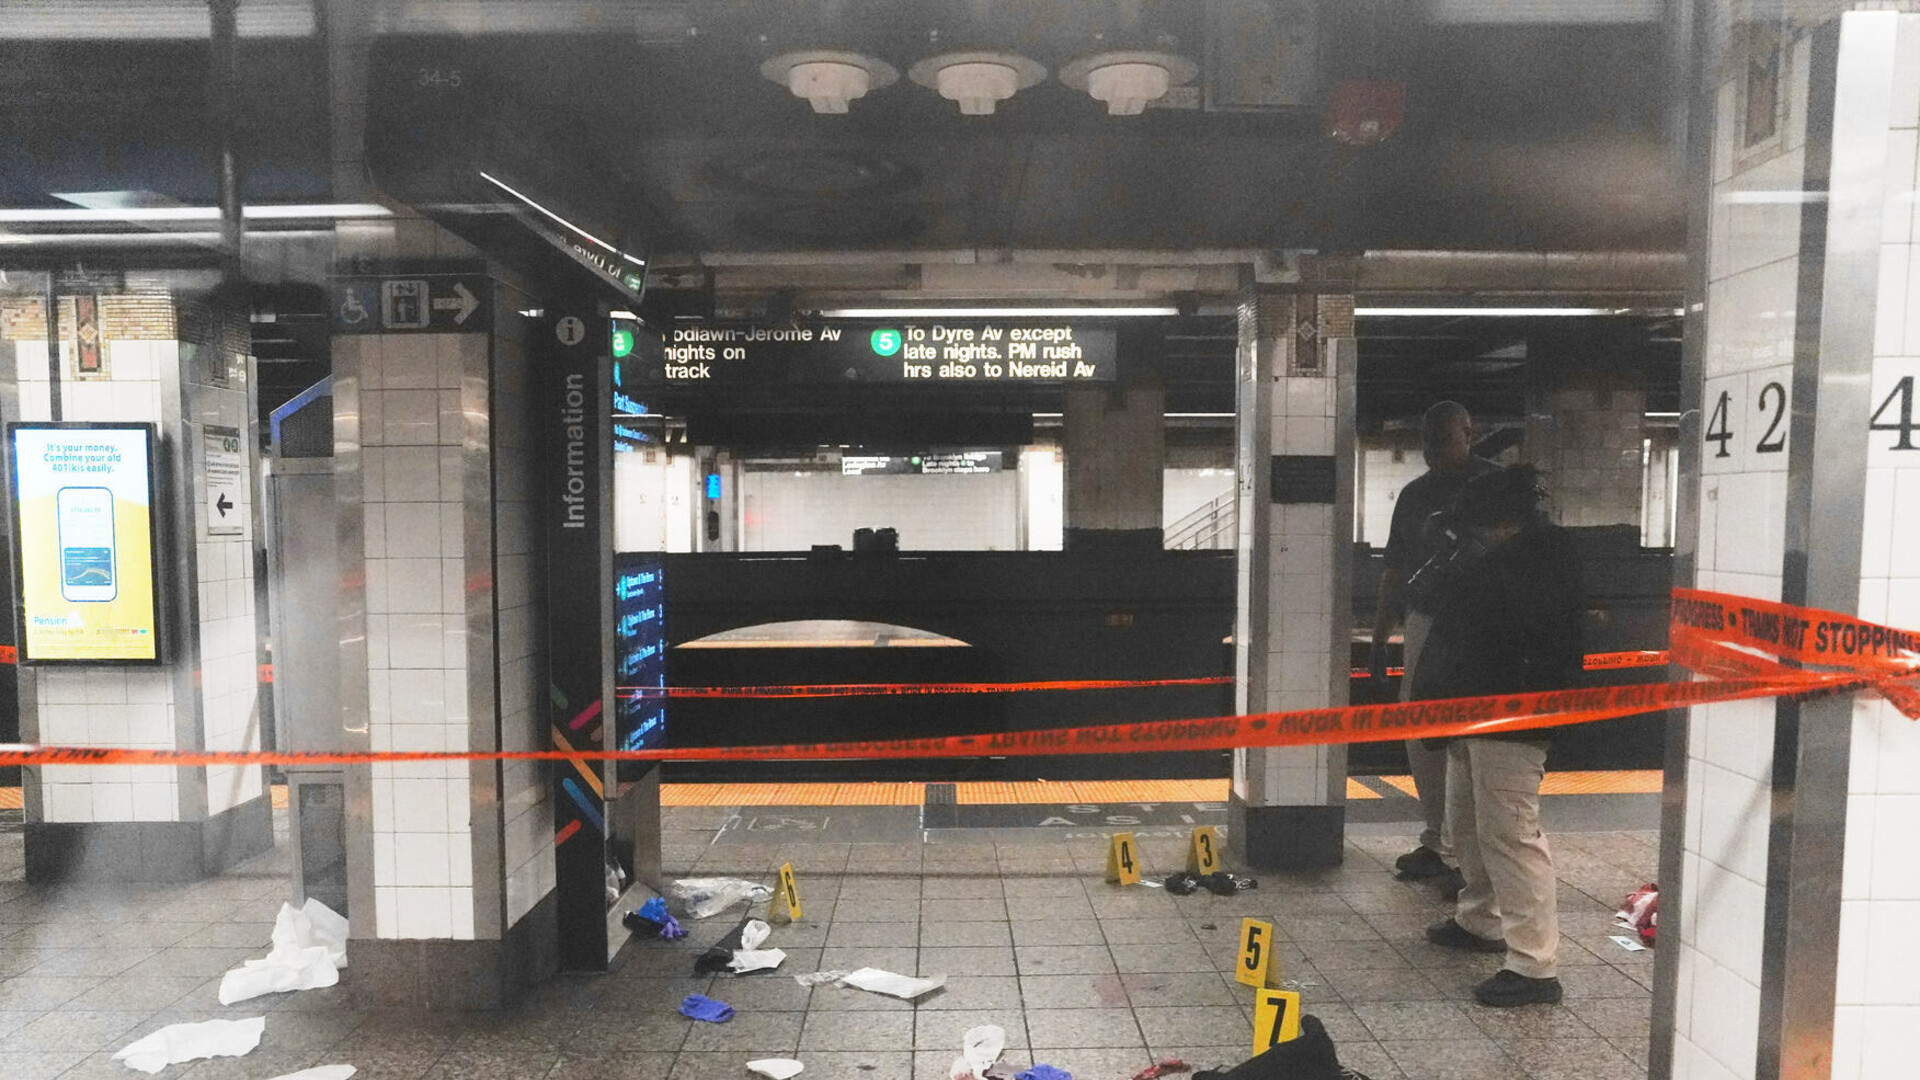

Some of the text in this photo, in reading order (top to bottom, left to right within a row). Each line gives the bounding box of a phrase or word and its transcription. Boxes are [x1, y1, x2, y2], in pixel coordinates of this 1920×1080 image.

[819, 326, 842, 342] Av
[879, 333, 892, 349] 5
[904, 325, 1072, 344] To Dyre Av except
[664, 344, 746, 364] nights on
[904, 343, 1082, 363] late nights. PM rush
[665, 363, 711, 379] track
[904, 362, 1096, 377] hrs also to Nereid Av
[44, 453, 122, 464] Combine your old
[63, 445, 82, 454] your
[85, 445, 118, 454] money.
[563, 374, 584, 528] Information
[86, 464, 115, 474] easily.
[34, 616, 68, 625] Pension
[1121, 841, 1133, 875] 4
[1200, 834, 1213, 868] 3
[785, 870, 797, 909] 6
[1245, 927, 1262, 971] 5
[1267, 997, 1287, 1047] 7
